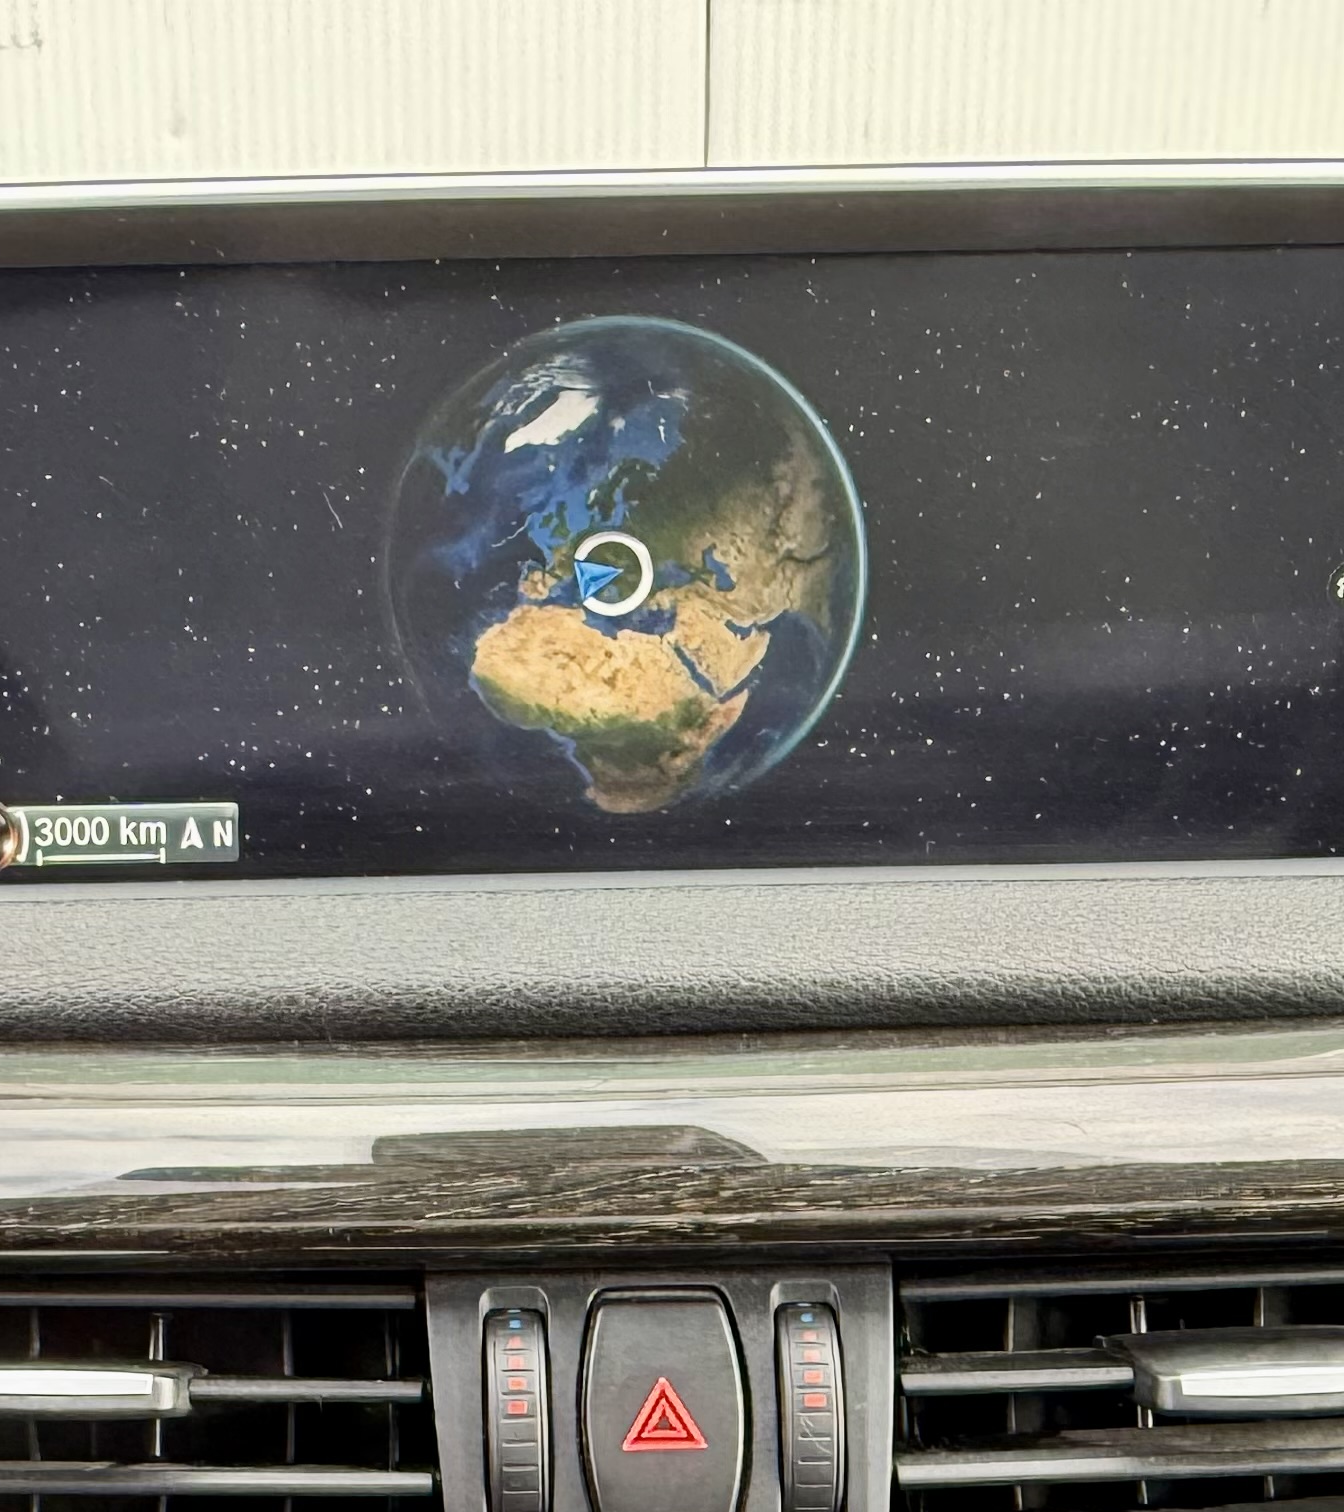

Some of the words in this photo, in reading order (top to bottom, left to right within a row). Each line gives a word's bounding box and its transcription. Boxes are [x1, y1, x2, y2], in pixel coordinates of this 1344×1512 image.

[35, 816, 109, 846] 3000
[120, 815, 167, 845] km
[213, 819, 233, 847] N
